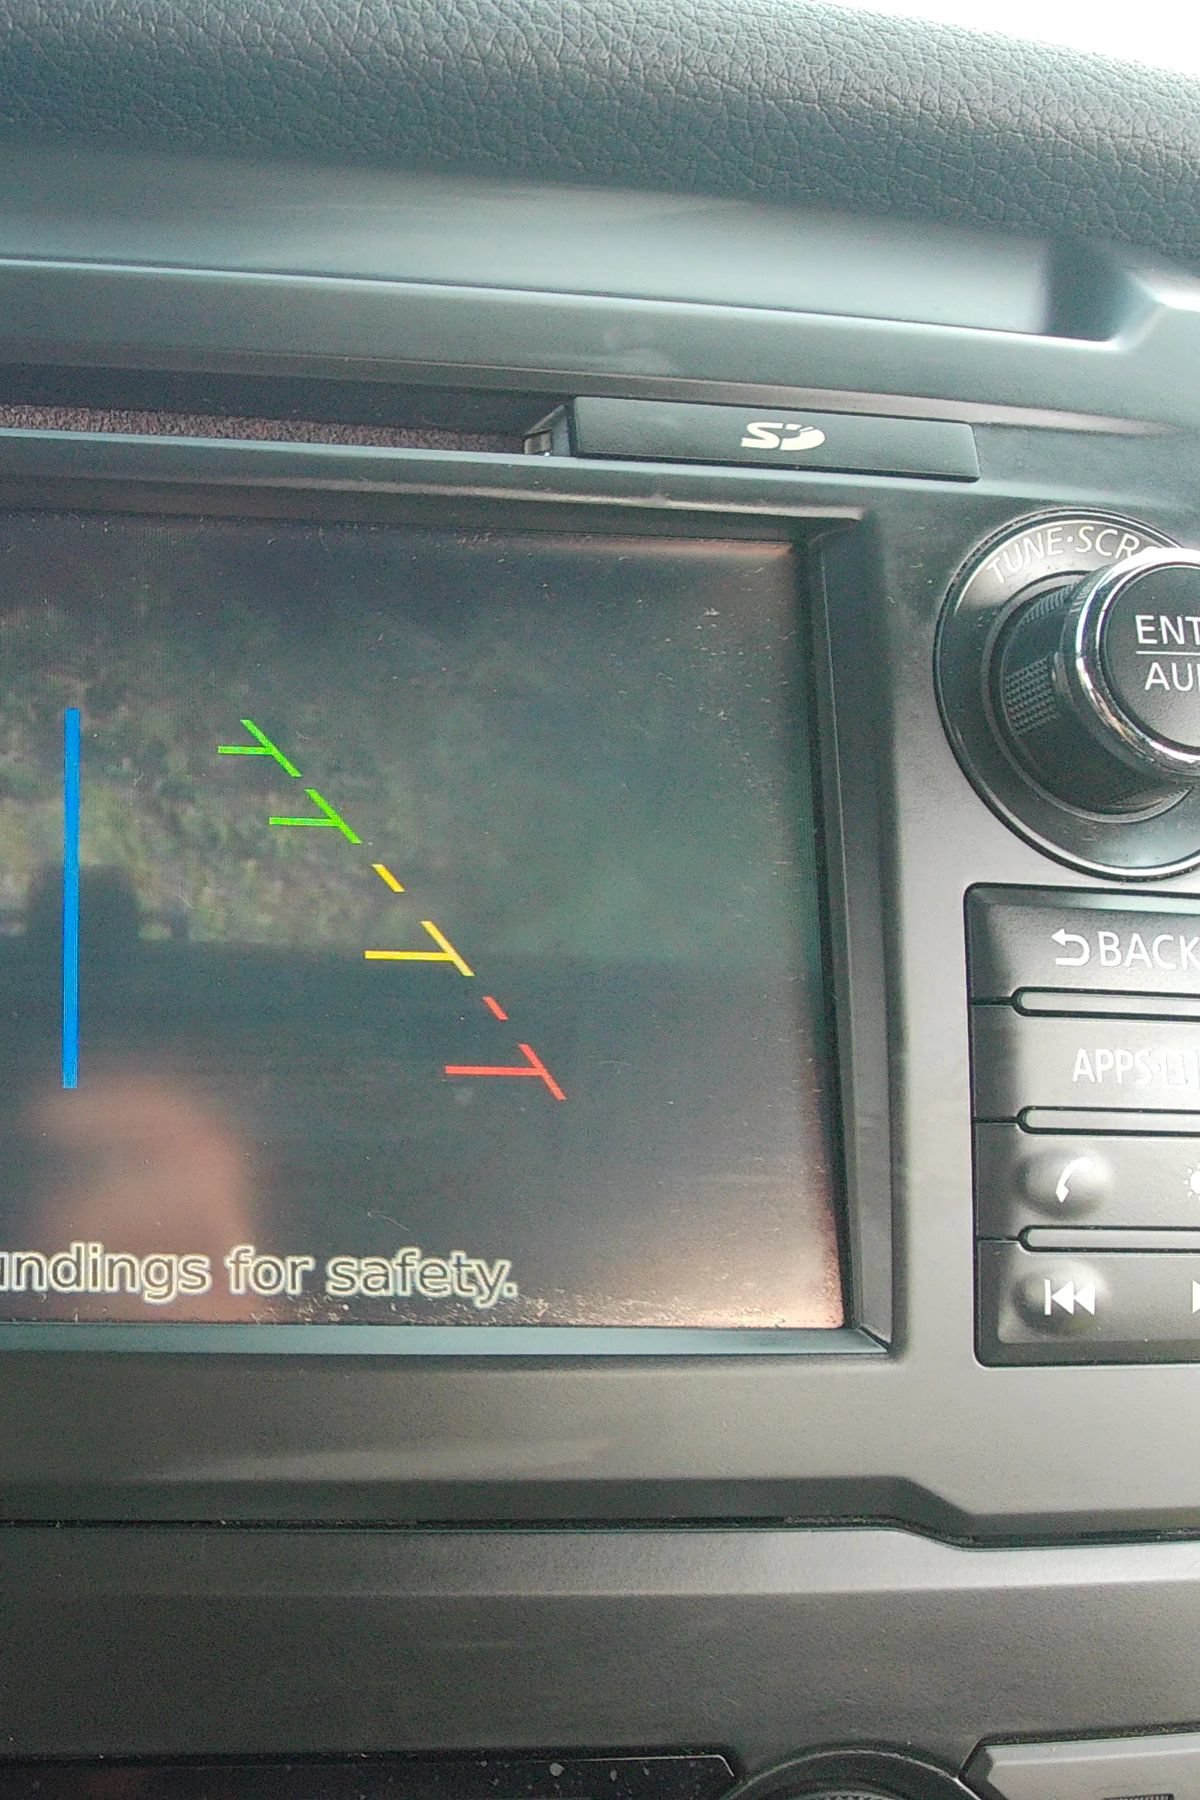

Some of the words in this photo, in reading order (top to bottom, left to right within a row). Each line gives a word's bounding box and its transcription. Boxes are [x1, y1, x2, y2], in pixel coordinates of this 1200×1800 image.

[741, 421, 826, 451] SD
[1144, 661, 1200, 692] AU
[1097, 931, 1200, 971] BACK
[224, 1244, 316, 1296] for
[326, 1246, 519, 1307] safety.
